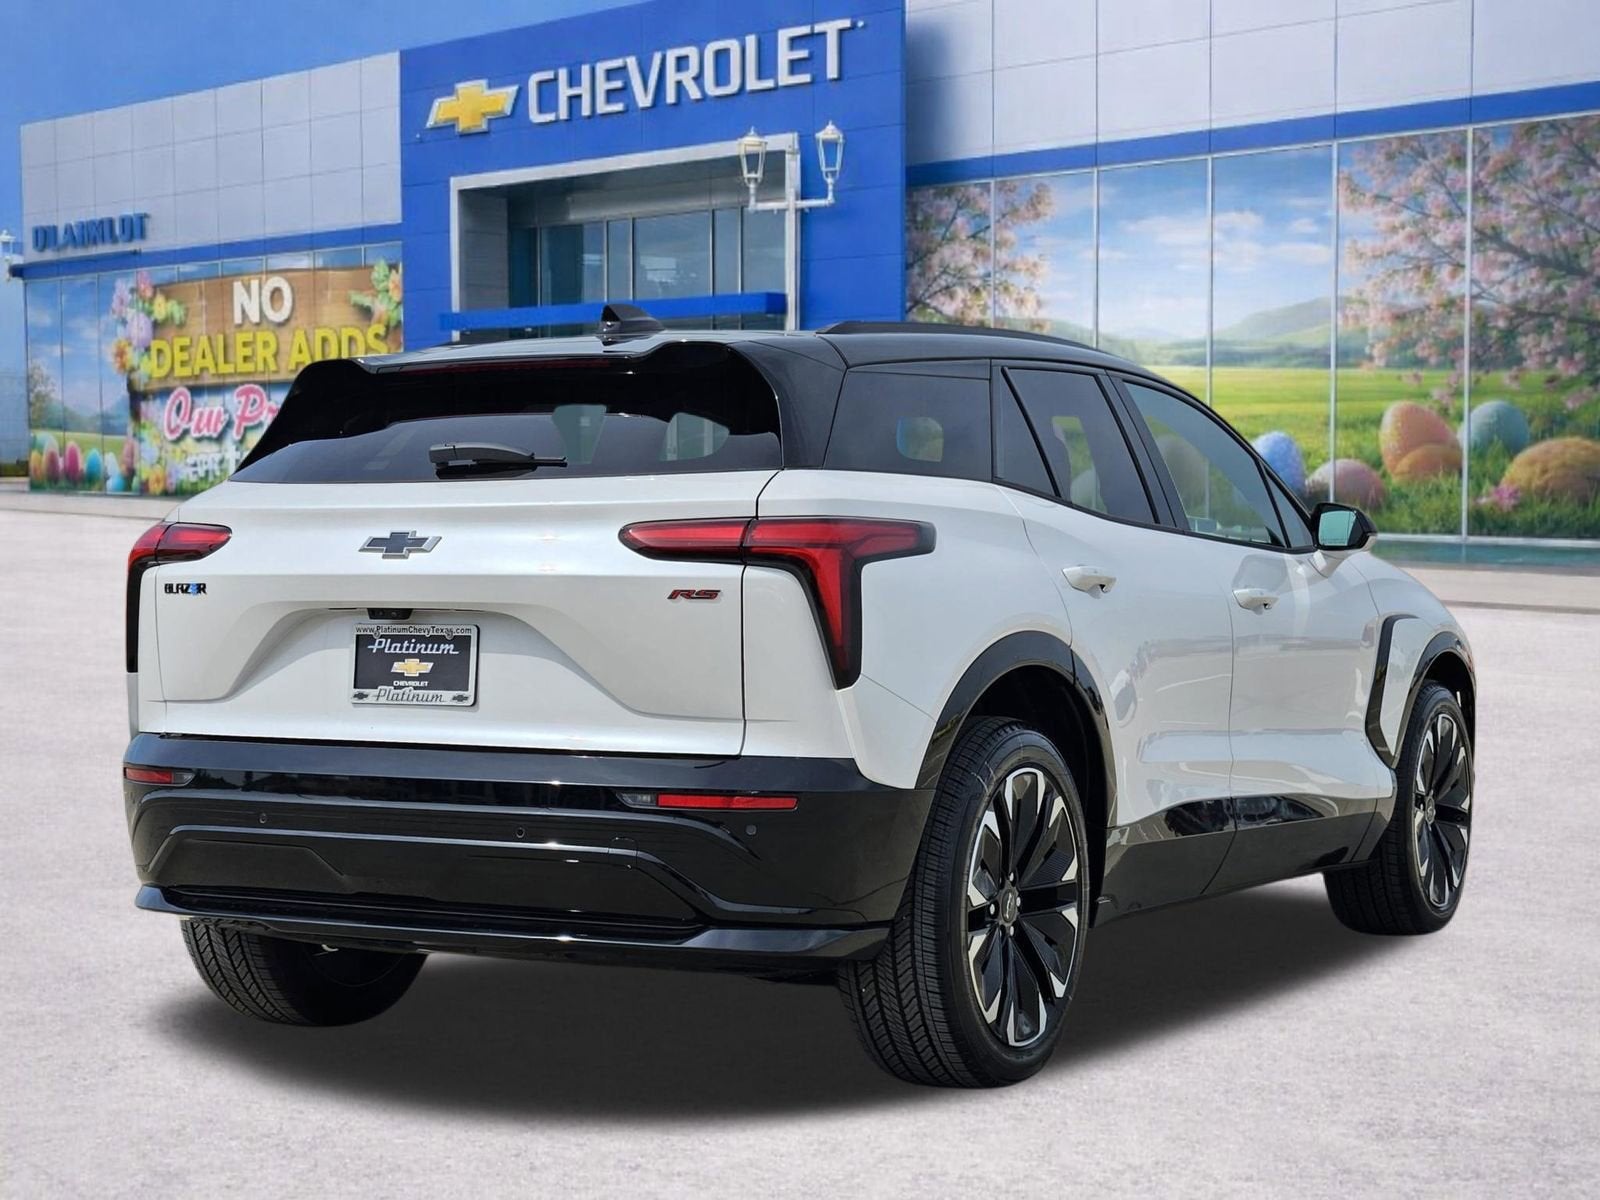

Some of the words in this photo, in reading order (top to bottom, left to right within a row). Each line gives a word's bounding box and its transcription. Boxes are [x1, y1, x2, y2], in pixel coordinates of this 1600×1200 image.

[528, 19, 852, 124] CHEVROLET
[233, 276, 293, 325] NO
[151, 330, 279, 379] DEALER
[288, 323, 389, 371] ADDS
[667, 589, 721, 600] RS
[355, 625, 472, 636] www.PlatinumChevyTexas.com
[367, 638, 460, 654] Platinum
[373, 687, 447, 702] Platinum
